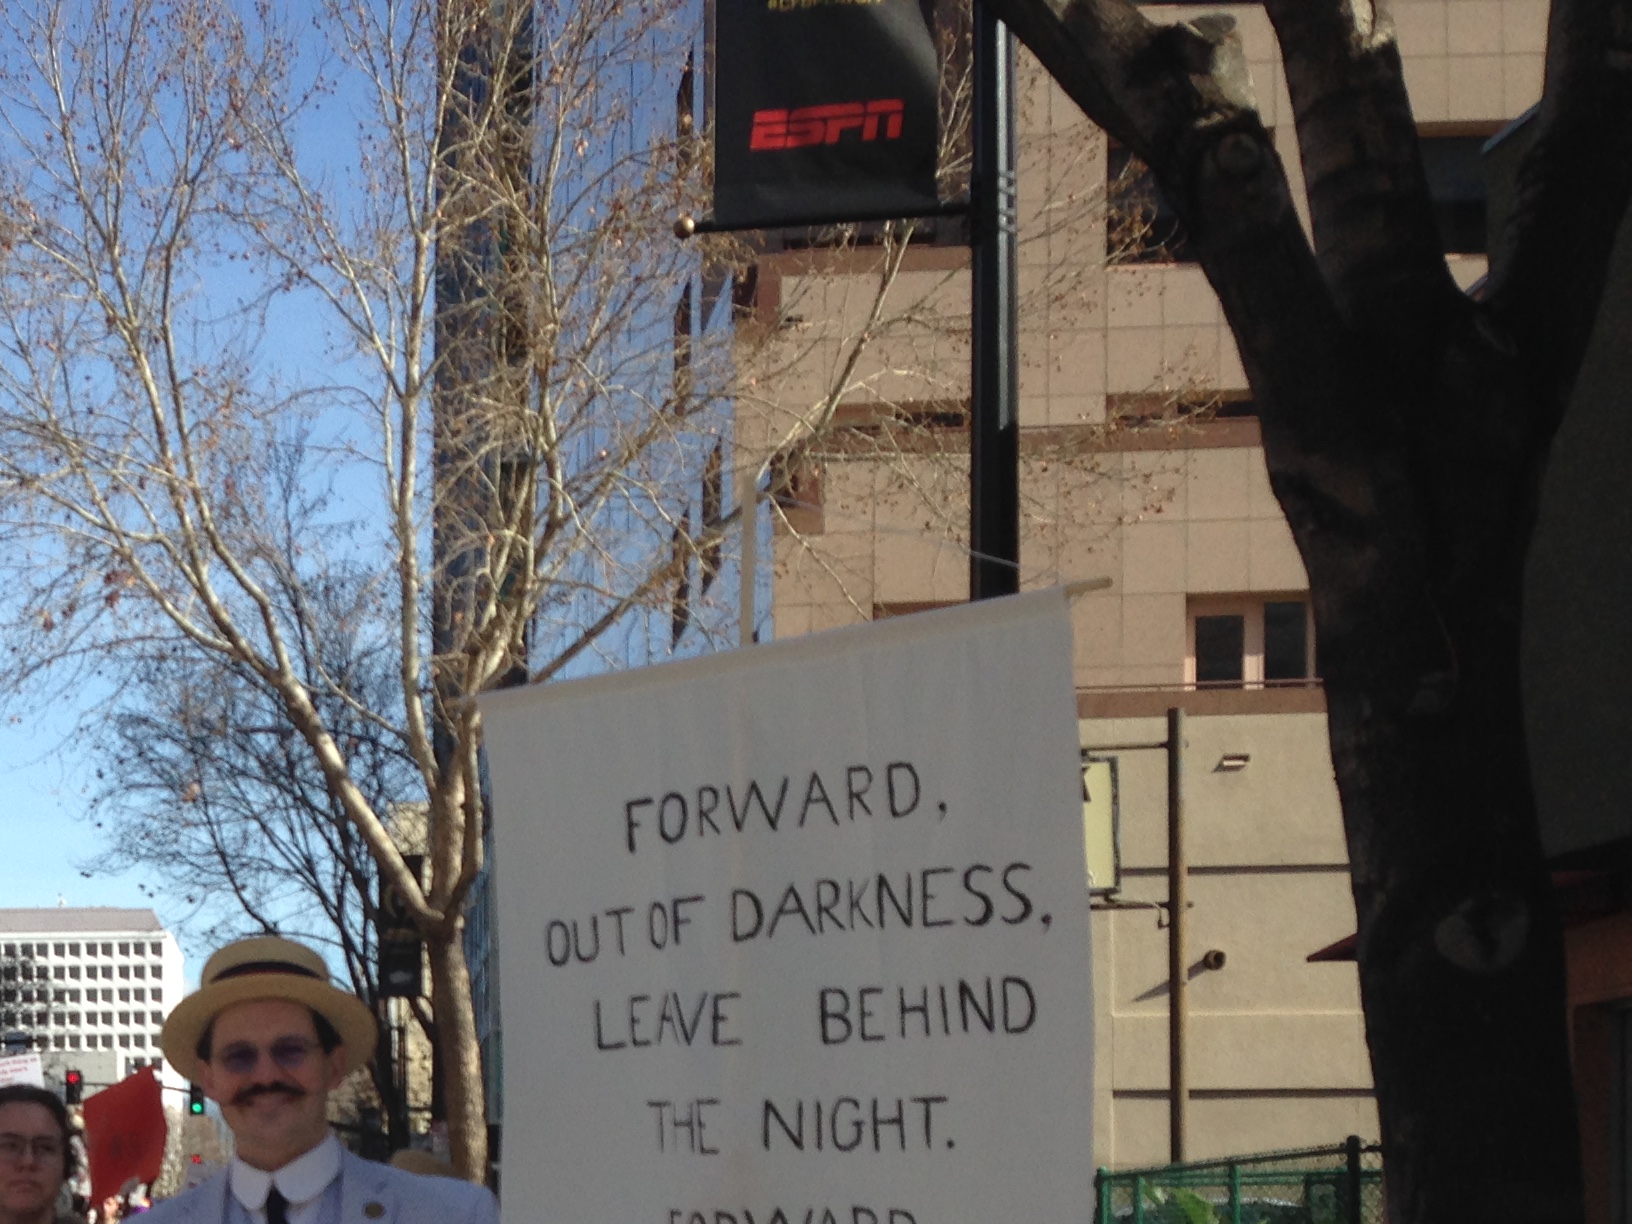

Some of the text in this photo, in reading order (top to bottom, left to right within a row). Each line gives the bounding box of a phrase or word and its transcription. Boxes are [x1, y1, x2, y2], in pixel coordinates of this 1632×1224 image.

[749, 98, 905, 152] ESPN
[544, 861, 1053, 967] OUT OF DARKNESS,
[594, 976, 1037, 1052] LEAVE BEHIND
[647, 1095, 956, 1156] THE NIGHT.
